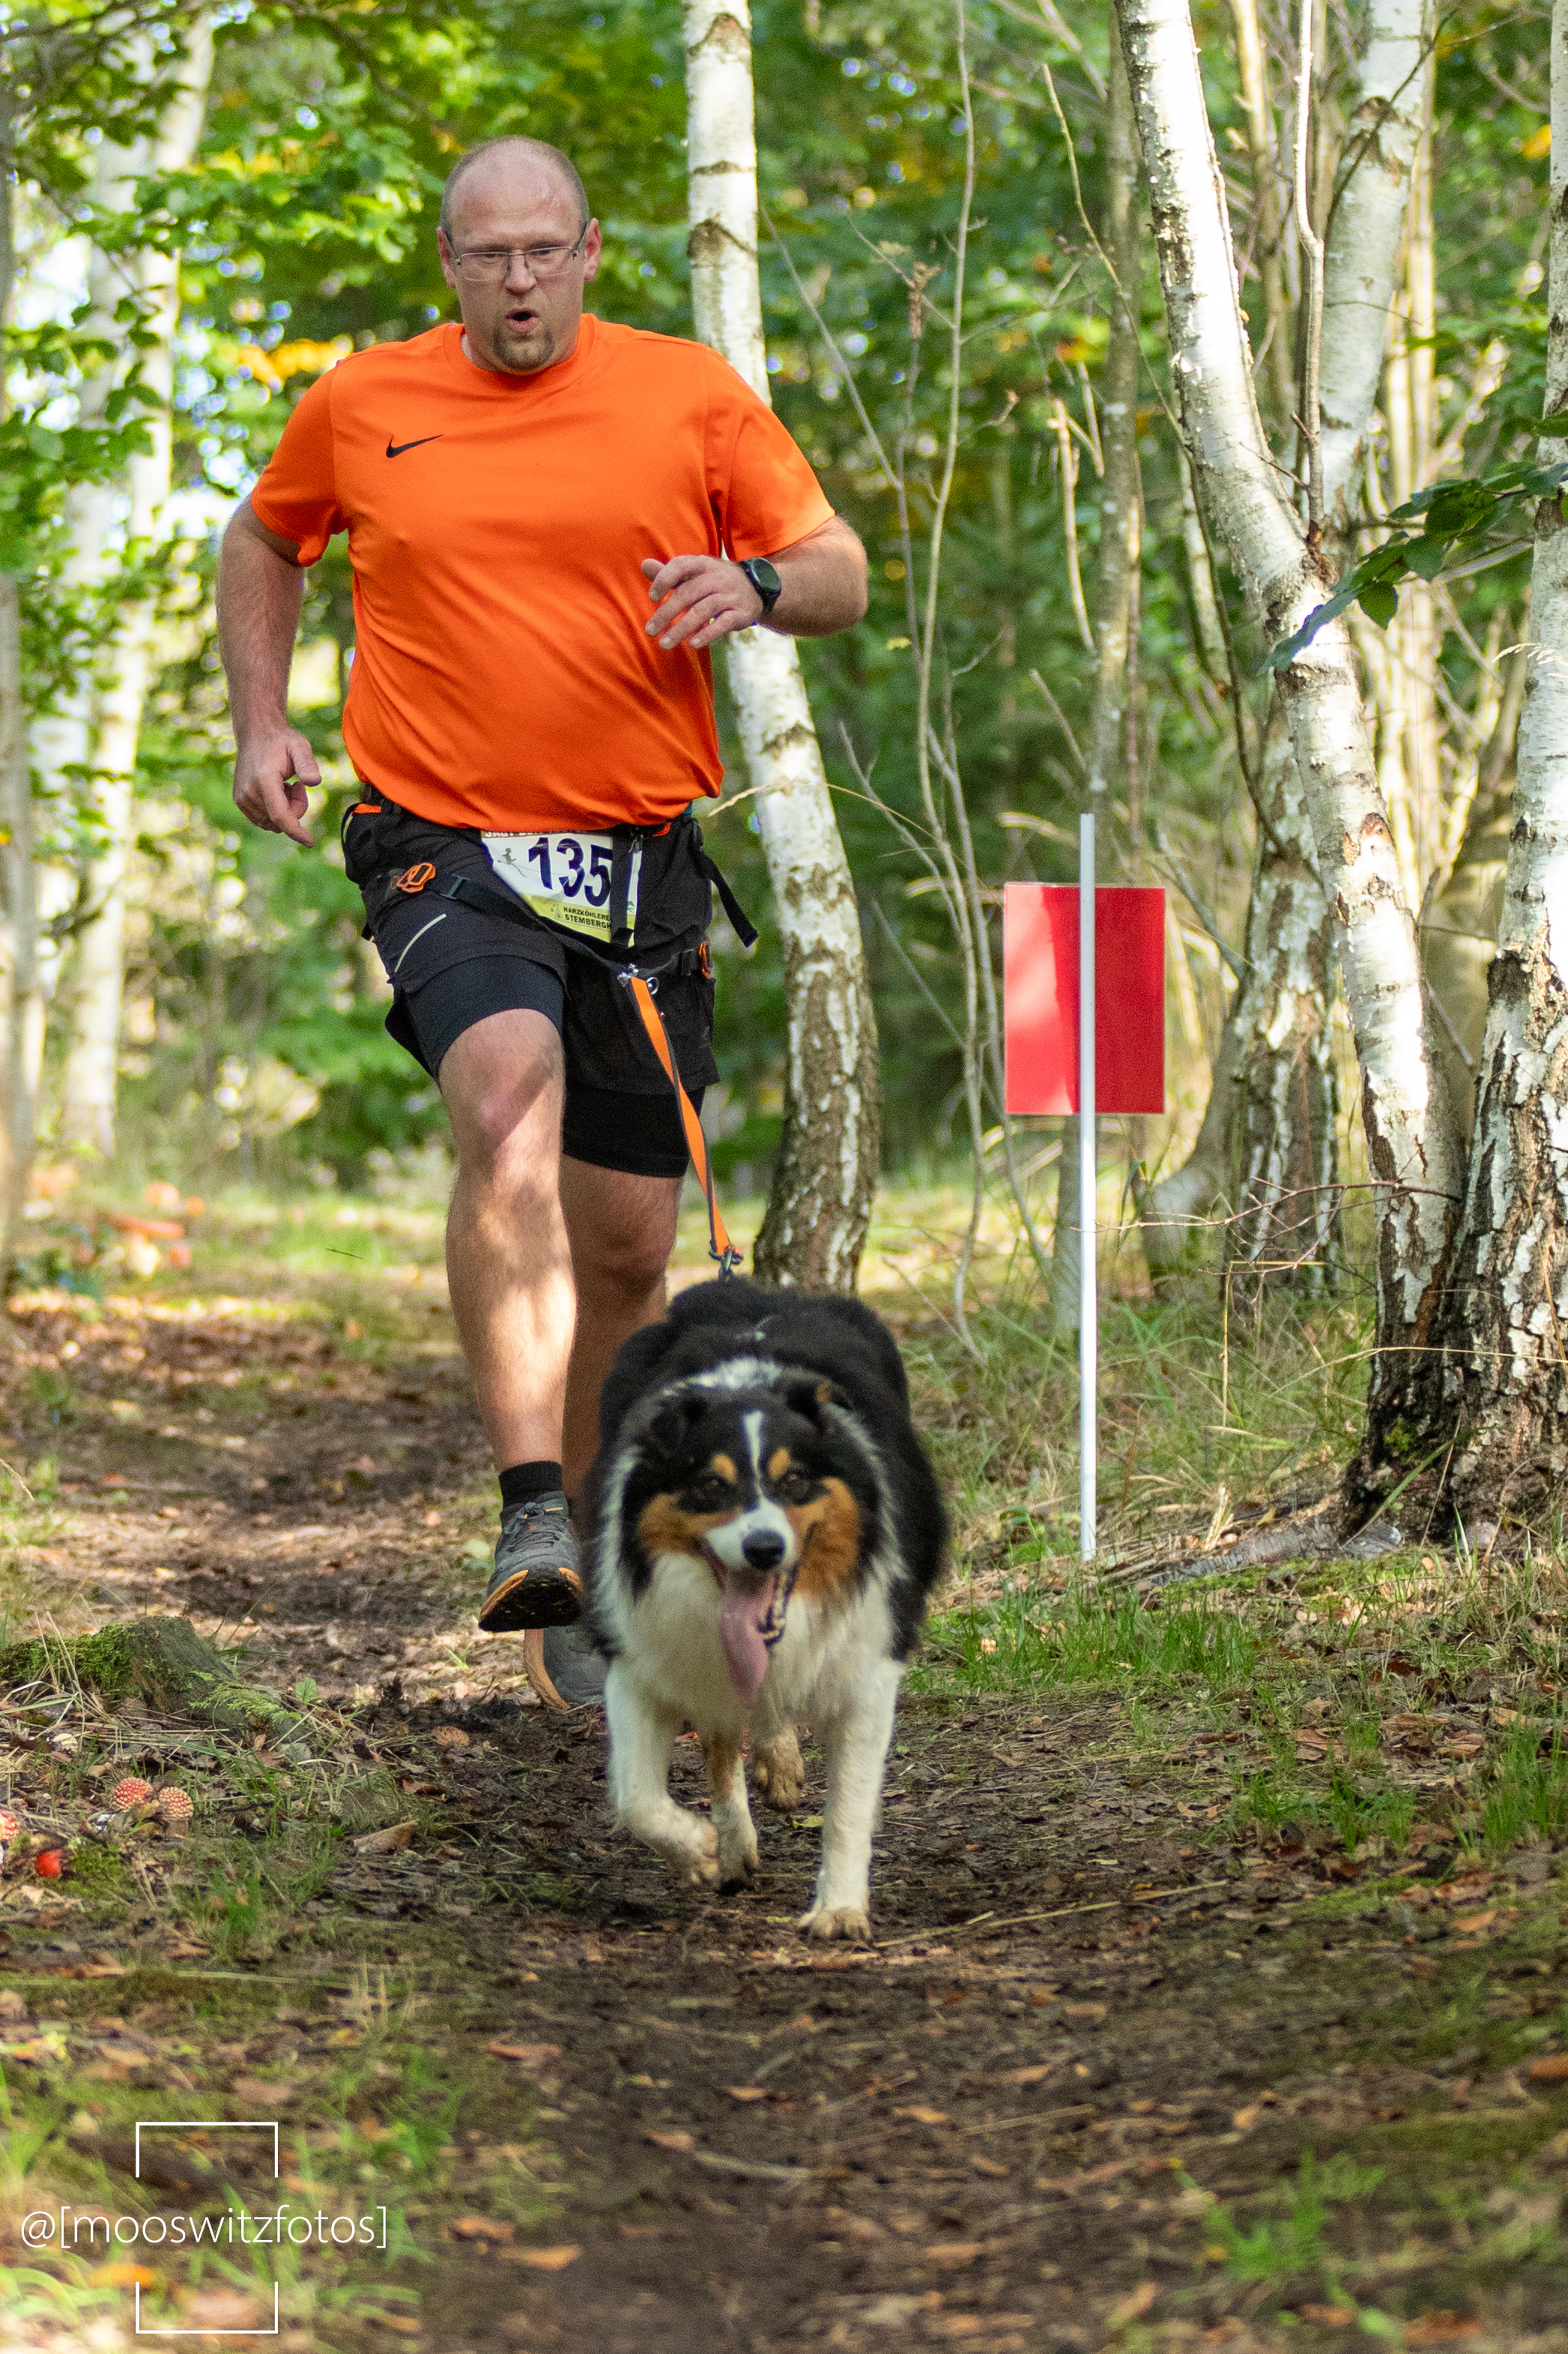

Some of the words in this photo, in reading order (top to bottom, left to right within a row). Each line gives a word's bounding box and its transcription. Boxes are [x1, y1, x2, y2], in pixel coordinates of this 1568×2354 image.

[528, 837, 613, 907] 135
[563, 906, 611, 922] HARZKÖHLERE
[565, 913, 611, 930] STEMBERGH
